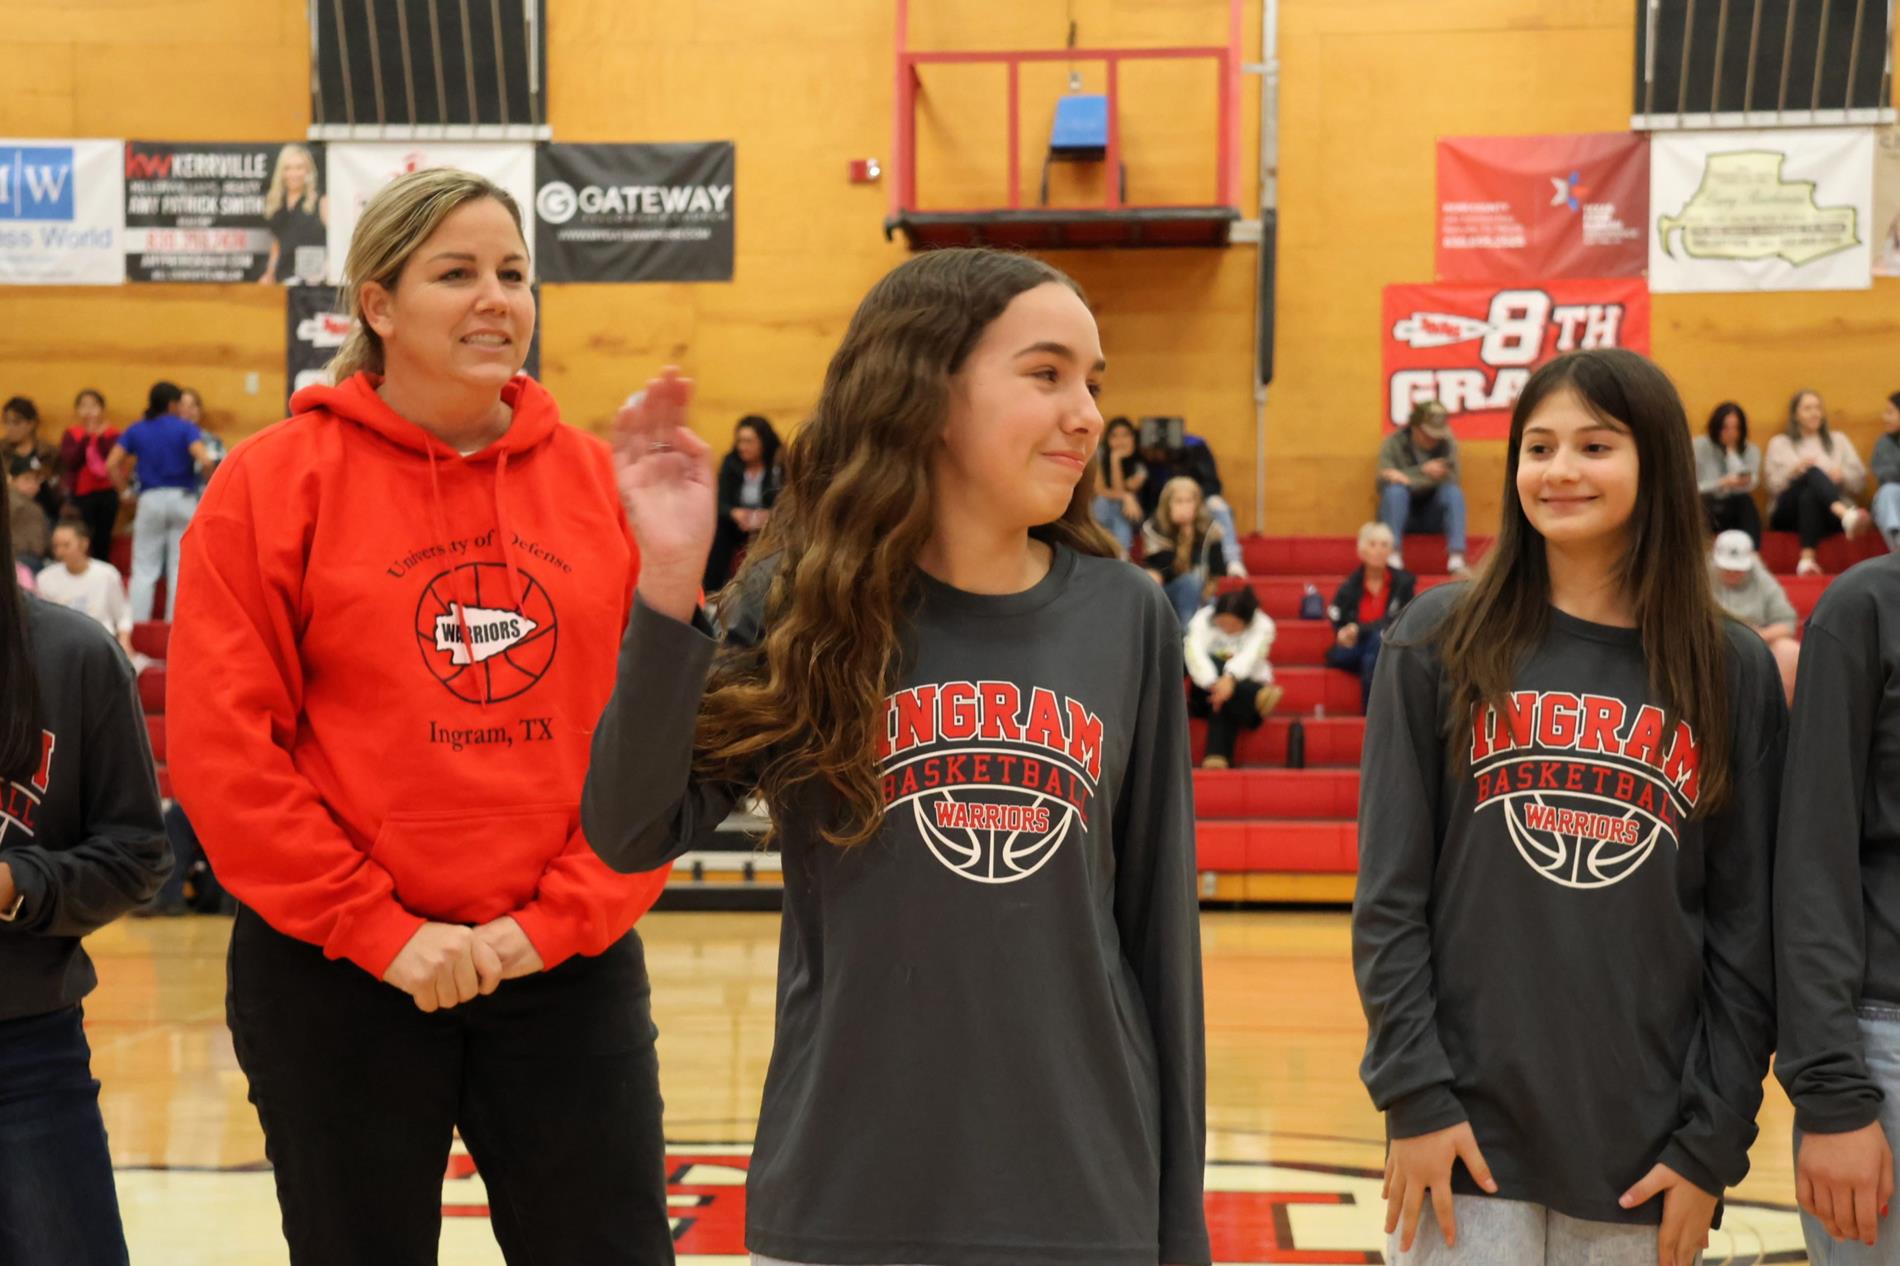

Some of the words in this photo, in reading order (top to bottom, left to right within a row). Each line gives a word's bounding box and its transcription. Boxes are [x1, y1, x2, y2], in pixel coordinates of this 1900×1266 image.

[172, 153, 268, 178] KERRVILLE
[578, 185, 732, 214] GATEWAY
[1391, 369, 1531, 425] GRA
[387, 539, 468, 578] Universty
[474, 528, 496, 547] of
[429, 721, 513, 750] Ingram,
[519, 718, 554, 741] TX
[1470, 690, 1701, 808] INGRAM
[934, 800, 1050, 834] WARRIORS
[1523, 802, 1640, 846] WARRIORS
